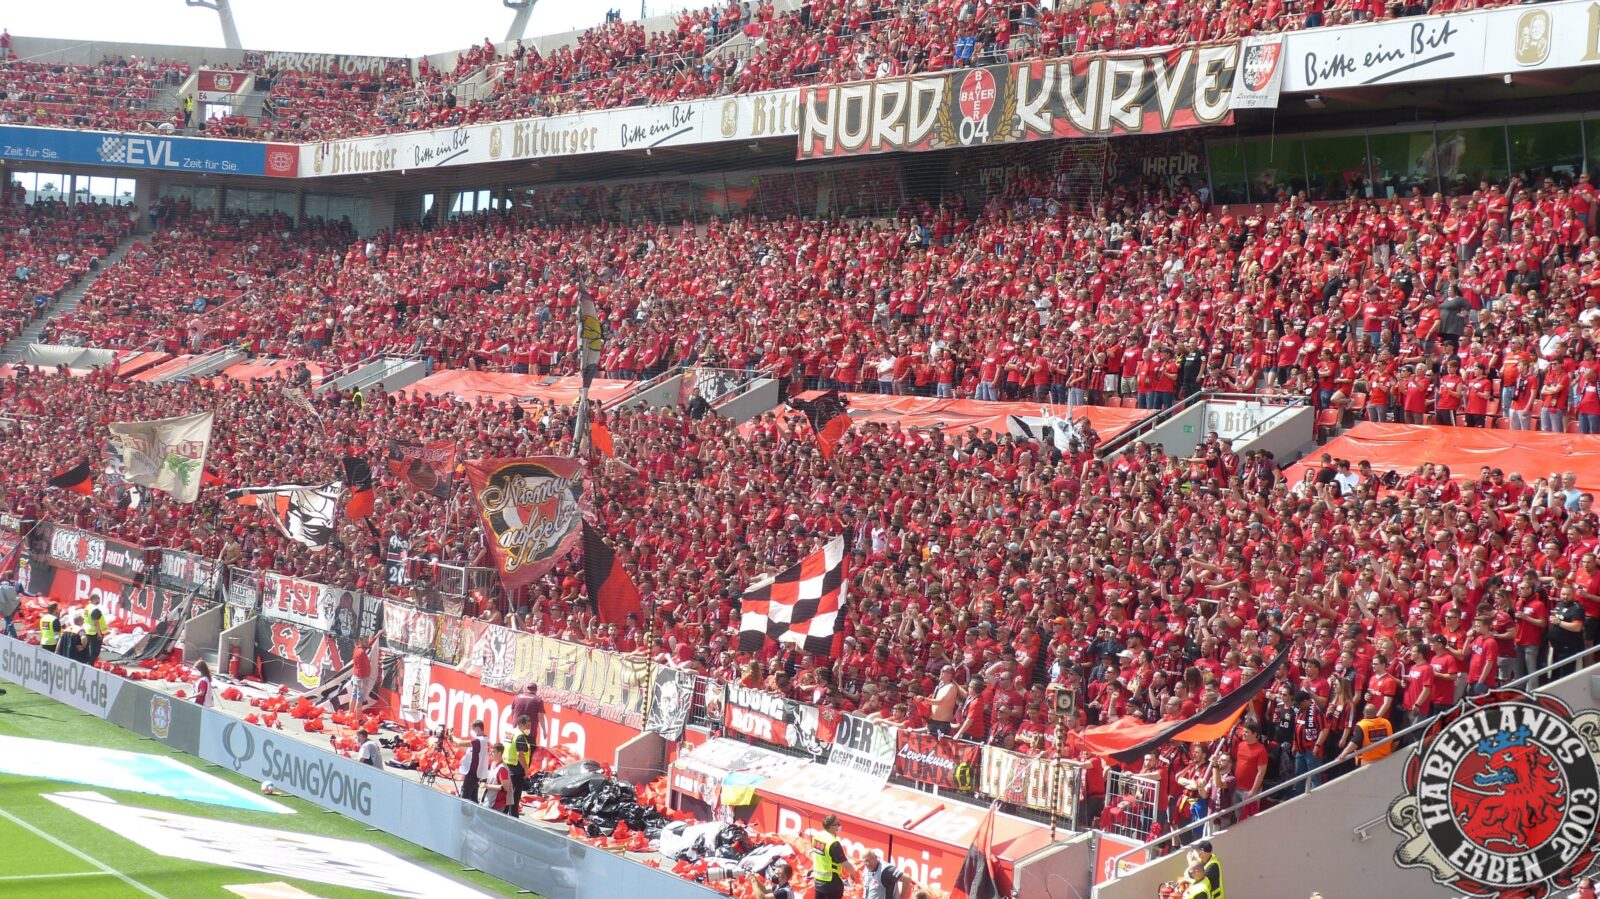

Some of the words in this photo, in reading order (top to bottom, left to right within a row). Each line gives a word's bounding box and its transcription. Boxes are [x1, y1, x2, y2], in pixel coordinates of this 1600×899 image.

[1305, 52, 1356, 86] Bitte
[1363, 44, 1405, 68] ein
[1410, 19, 1458, 54] Bit
[198, 92, 208, 101] E4
[803, 78, 945, 154] NORD
[1016, 45, 1238, 135] KURVE
[961, 88, 995, 100] BAYER
[622, 124, 646, 148] Bitte
[650, 120, 670, 135] ein
[672, 104, 695, 127] Bit
[752, 94, 800, 136] Bitb
[959, 114, 989, 147] 04
[4, 146, 23, 156] Zeit
[25, 147, 39, 158] für
[41, 149, 59, 159] Sie.
[127, 139, 179, 167] EVL
[331, 142, 397, 174] Bitburger
[415, 144, 434, 167] Bitte
[436, 143, 451, 157] ein
[453, 130, 469, 151] Bit
[513, 122, 597, 158] Bitburger
[184, 158, 202, 169] Zeit
[205, 159, 219, 170] für
[221, 160, 240, 171] Sie.
[1168, 152, 1198, 175] FÜR
[279, 578, 319, 618] FSI
[2, 641, 107, 709] shop.bayer04.de
[837, 714, 874, 753] DER
[898, 744, 955, 770] Leverkusen
[262, 739, 372, 816] SSANGYONG
